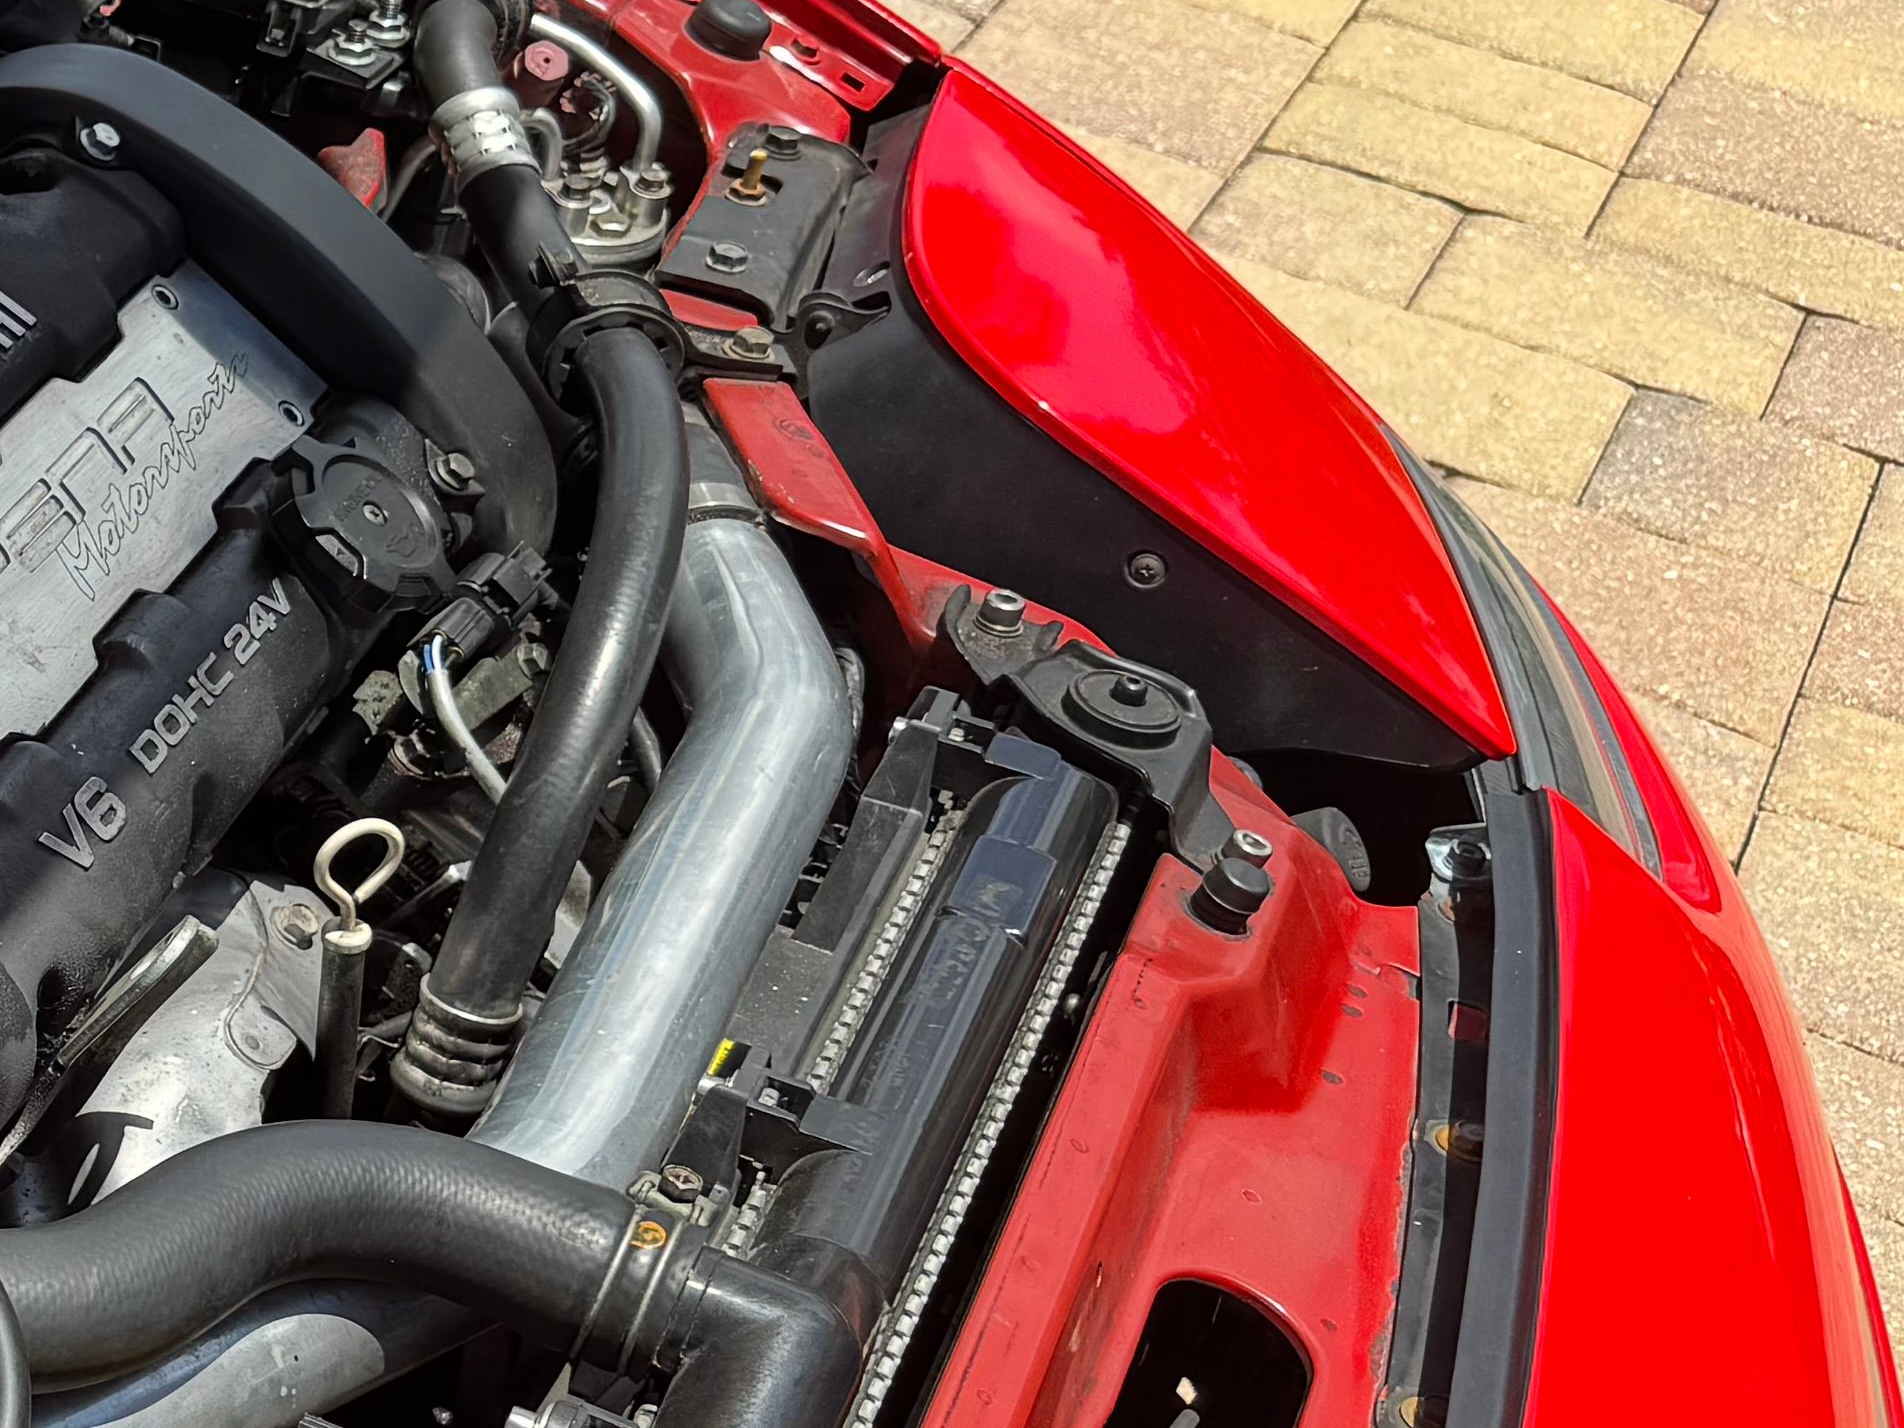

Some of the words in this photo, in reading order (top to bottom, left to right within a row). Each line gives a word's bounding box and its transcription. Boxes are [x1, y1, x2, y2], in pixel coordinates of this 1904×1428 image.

[37, 777, 128, 871] V6
[129, 650, 234, 776] DOHC
[227, 577, 291, 677] 24V
